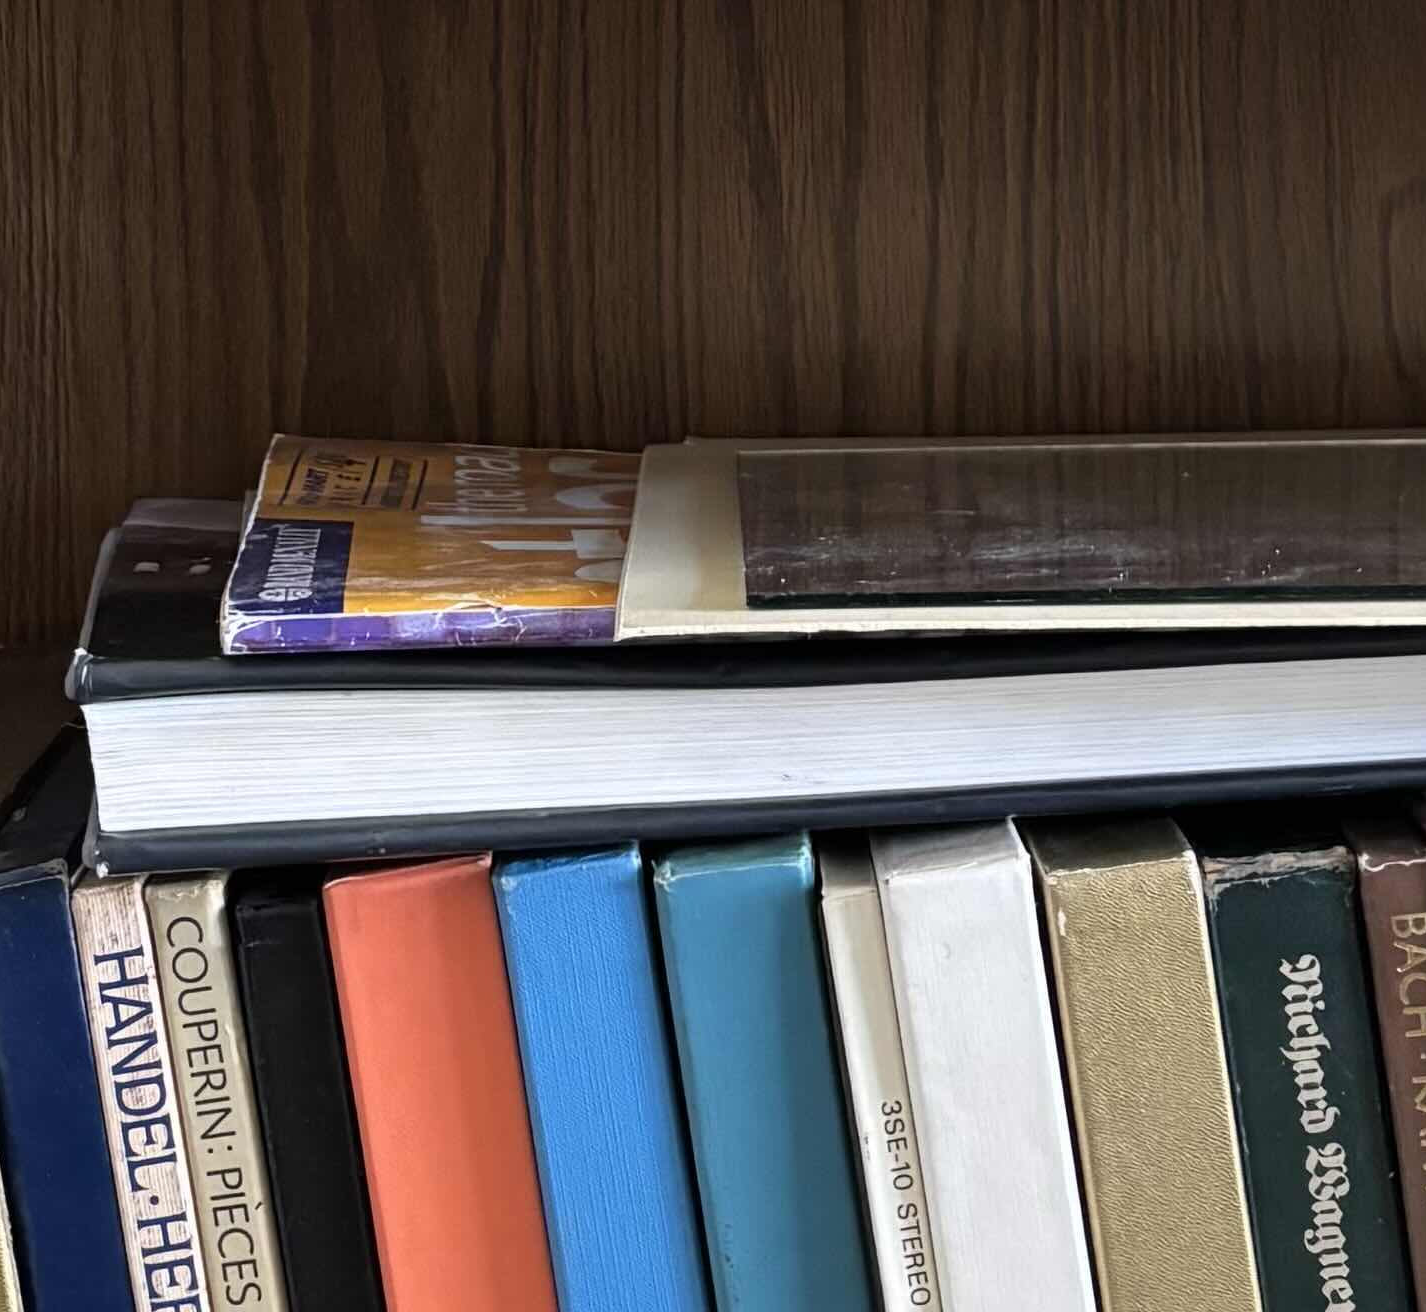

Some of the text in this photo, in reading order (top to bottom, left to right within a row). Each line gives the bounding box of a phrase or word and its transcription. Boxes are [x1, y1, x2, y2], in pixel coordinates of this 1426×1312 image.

[94, 947, 178, 1191] HANDEL
[166, 916, 236, 1155] COUPERIN:
[206, 1167, 267, 1306] PIÈCES
[1279, 953, 1341, 1134] Richard
[881, 1100, 931, 1306] 3SE-10 STEREO
